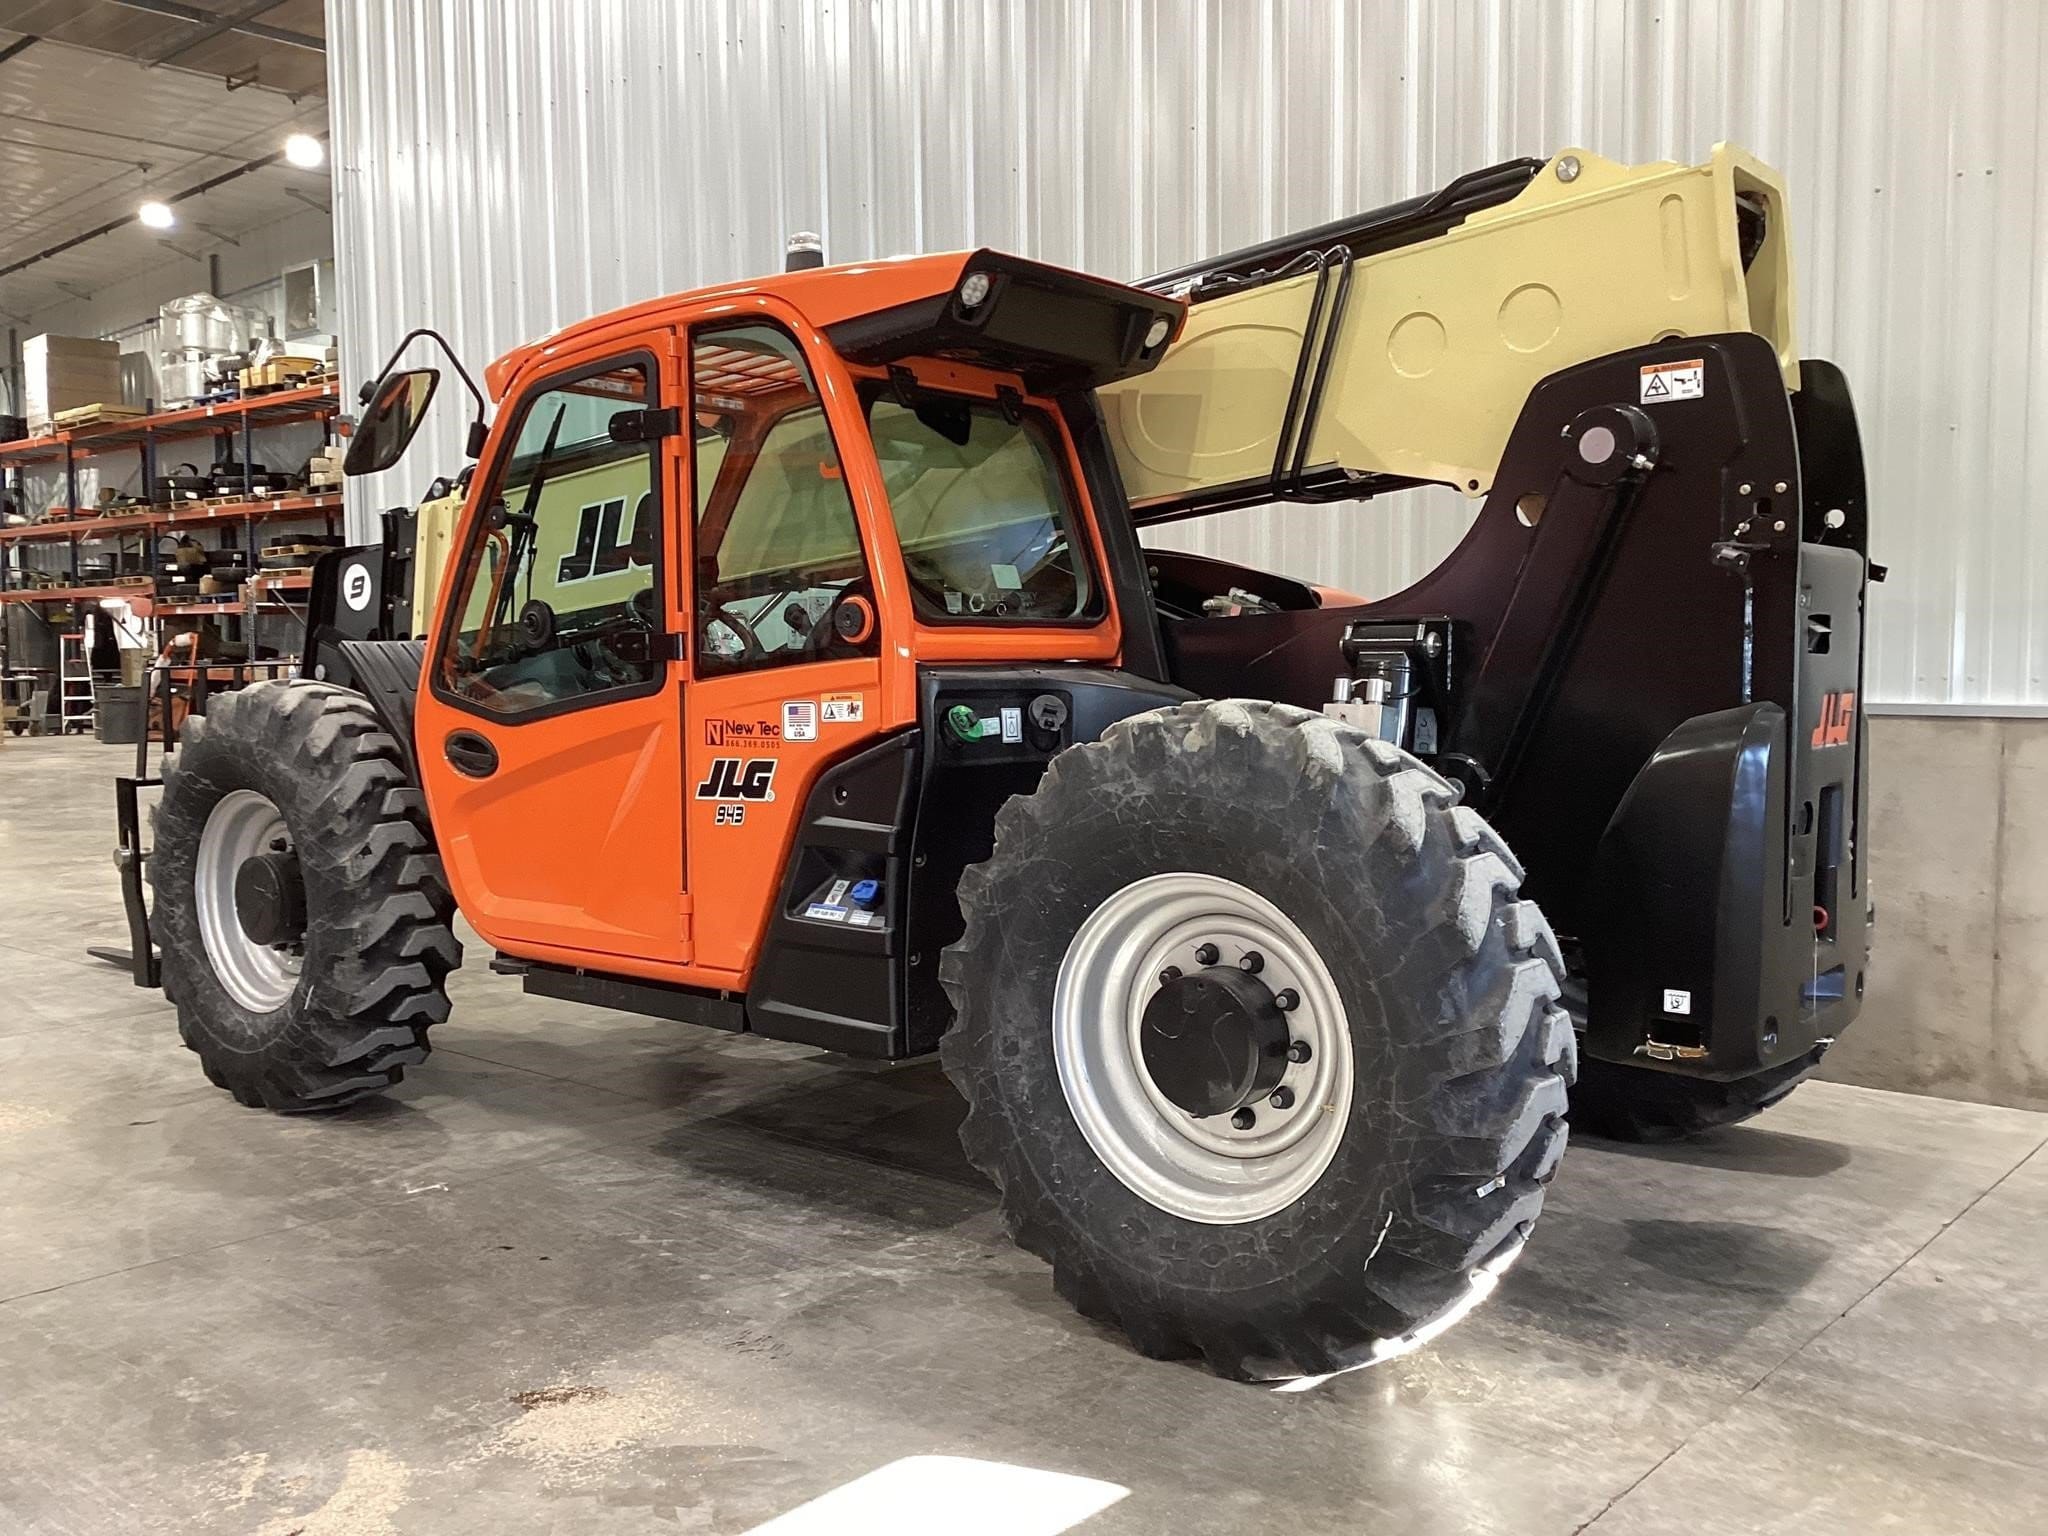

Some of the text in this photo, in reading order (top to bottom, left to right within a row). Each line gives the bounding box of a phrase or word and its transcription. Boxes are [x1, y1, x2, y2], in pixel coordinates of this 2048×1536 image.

[350, 575, 365, 600] 9
[725, 719, 755, 736] New
[757, 720, 781, 736] Tec
[1811, 692, 1854, 750] JLG
[696, 758, 778, 801] JLG
[715, 805, 744, 825] 943
